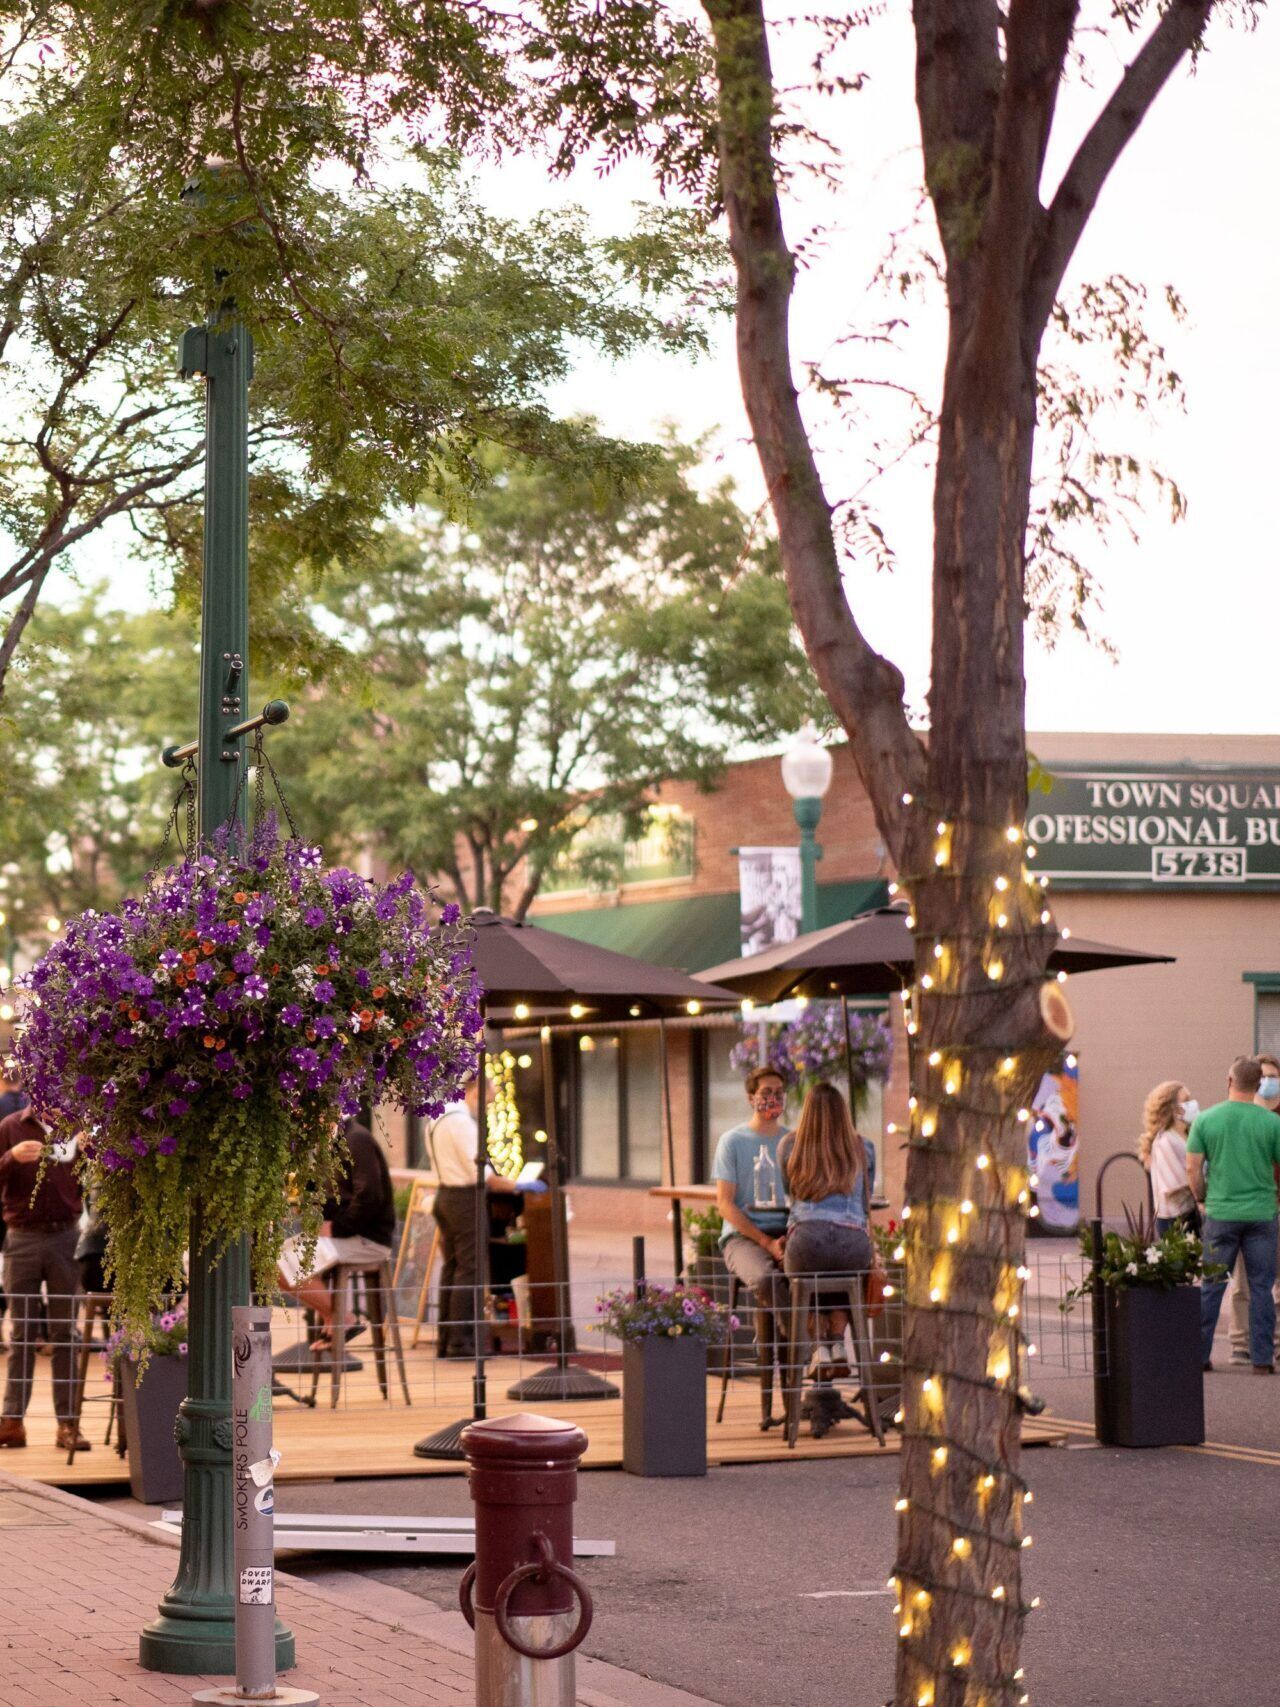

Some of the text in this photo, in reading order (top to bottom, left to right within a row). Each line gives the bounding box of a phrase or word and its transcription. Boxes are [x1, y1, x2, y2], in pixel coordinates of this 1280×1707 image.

[1086, 781, 1280, 813] TOWN SQUA
[1160, 851, 1240, 877] 5738
[235, 1408, 248, 1447] POLE
